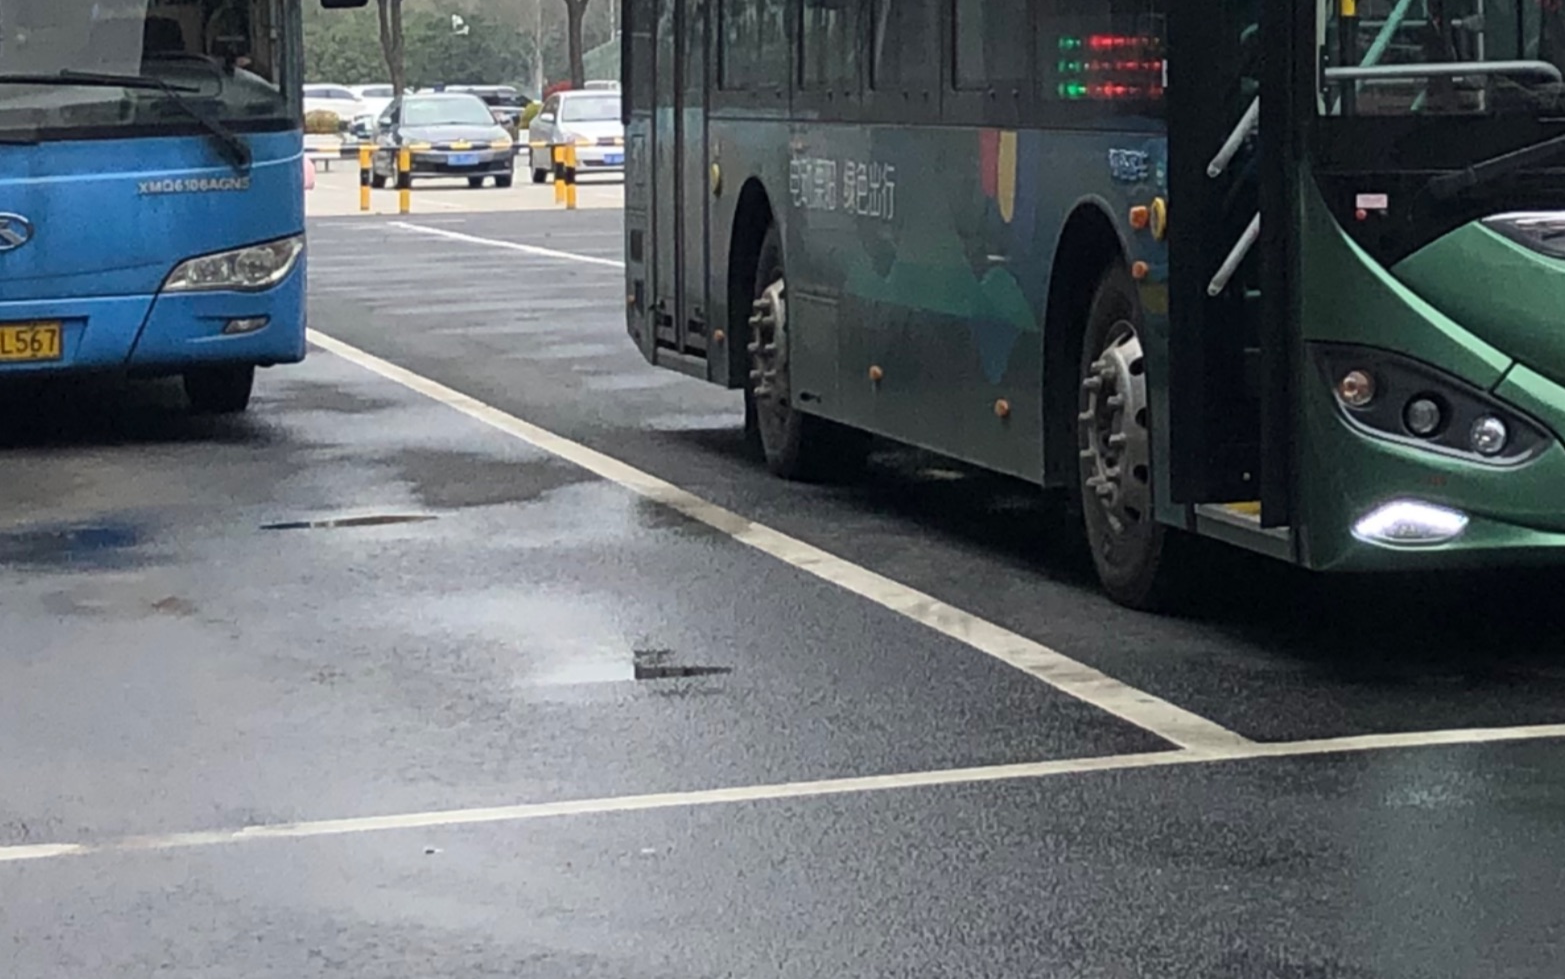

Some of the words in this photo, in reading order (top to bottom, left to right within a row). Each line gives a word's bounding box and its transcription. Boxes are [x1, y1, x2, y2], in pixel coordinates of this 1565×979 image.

[843, 160, 896, 221] 绿色出行
[0, 328, 57, 354] L567
